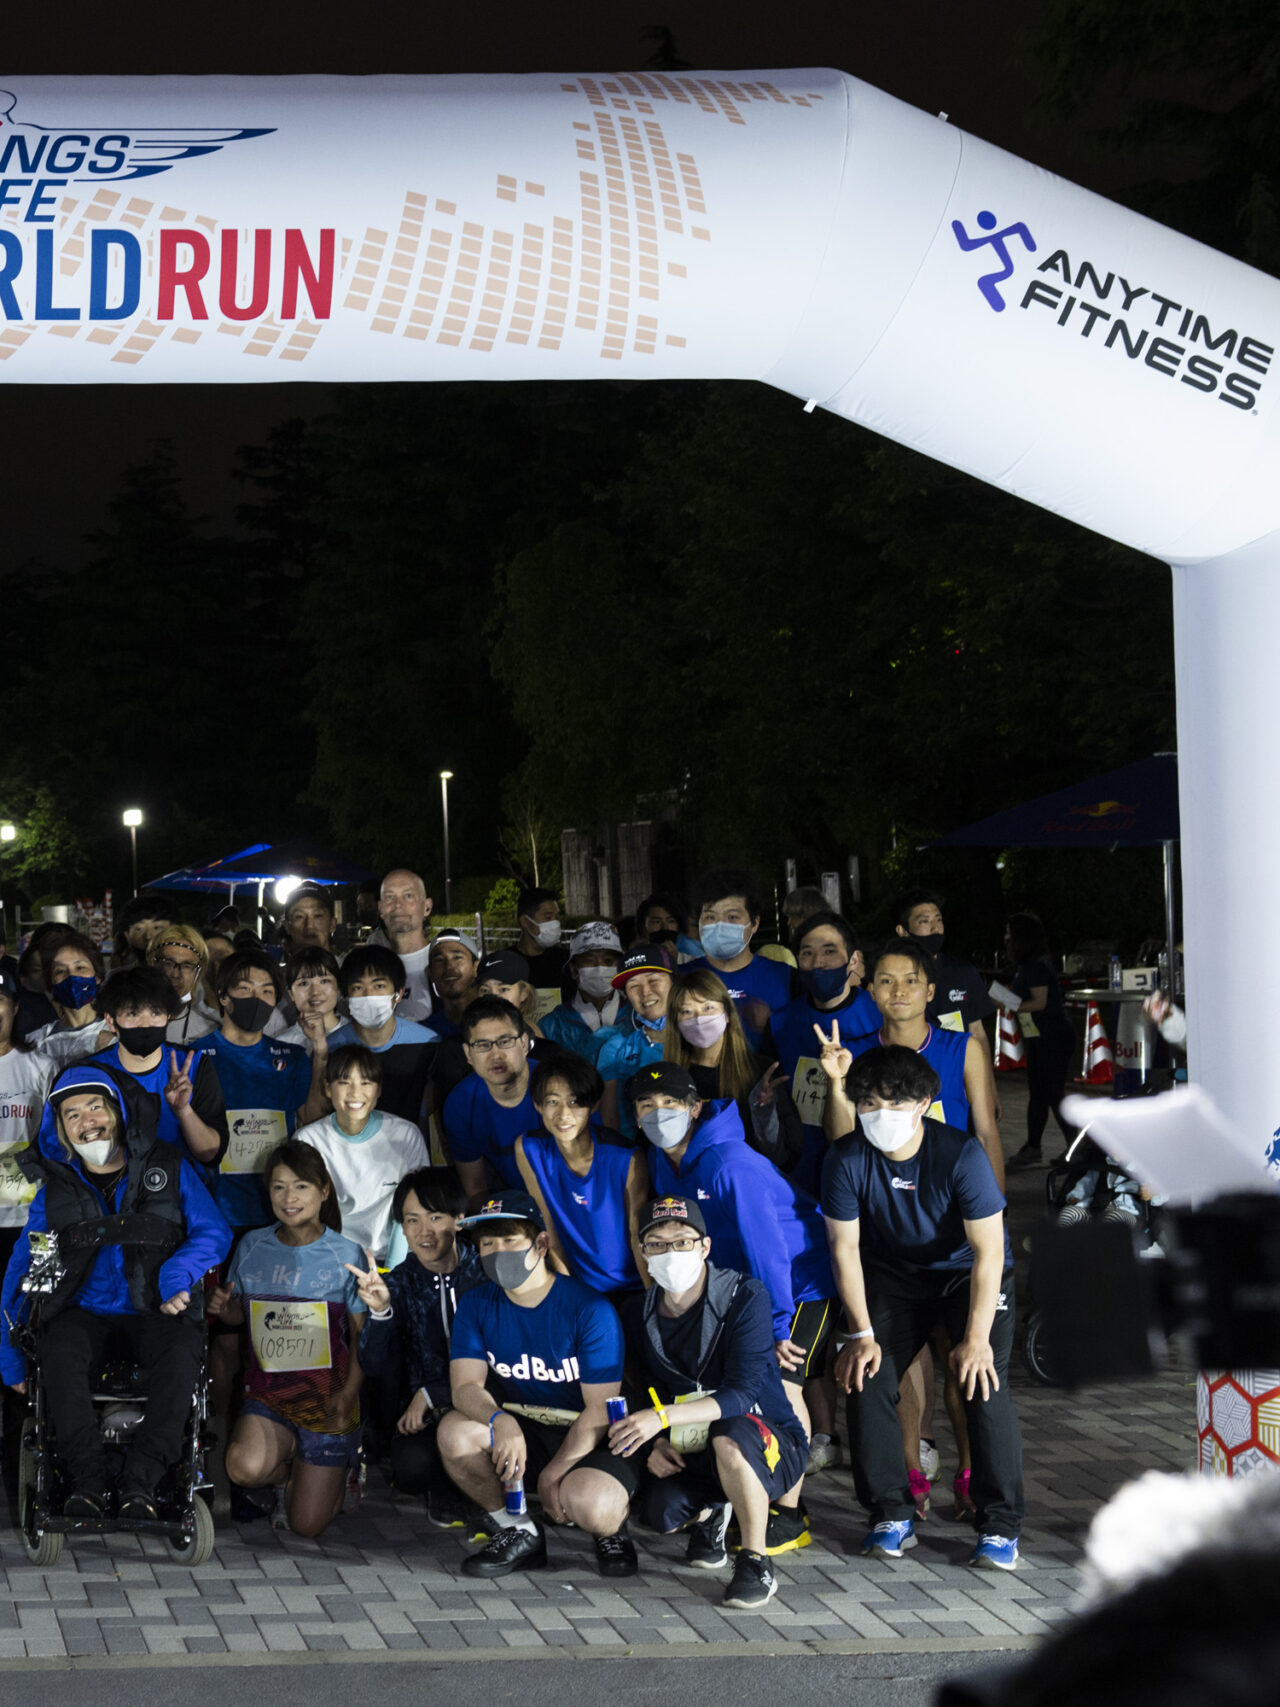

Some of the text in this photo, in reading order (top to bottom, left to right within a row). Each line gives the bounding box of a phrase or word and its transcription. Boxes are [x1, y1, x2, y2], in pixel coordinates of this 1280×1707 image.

[1037, 249, 1274, 375] ANYTIME
[1020, 280, 1262, 410] FITNESS
[271, 1265, 302, 1286] iki
[260, 1336, 314, 1359] 108571
[487, 1351, 580, 1383] Red Bull
